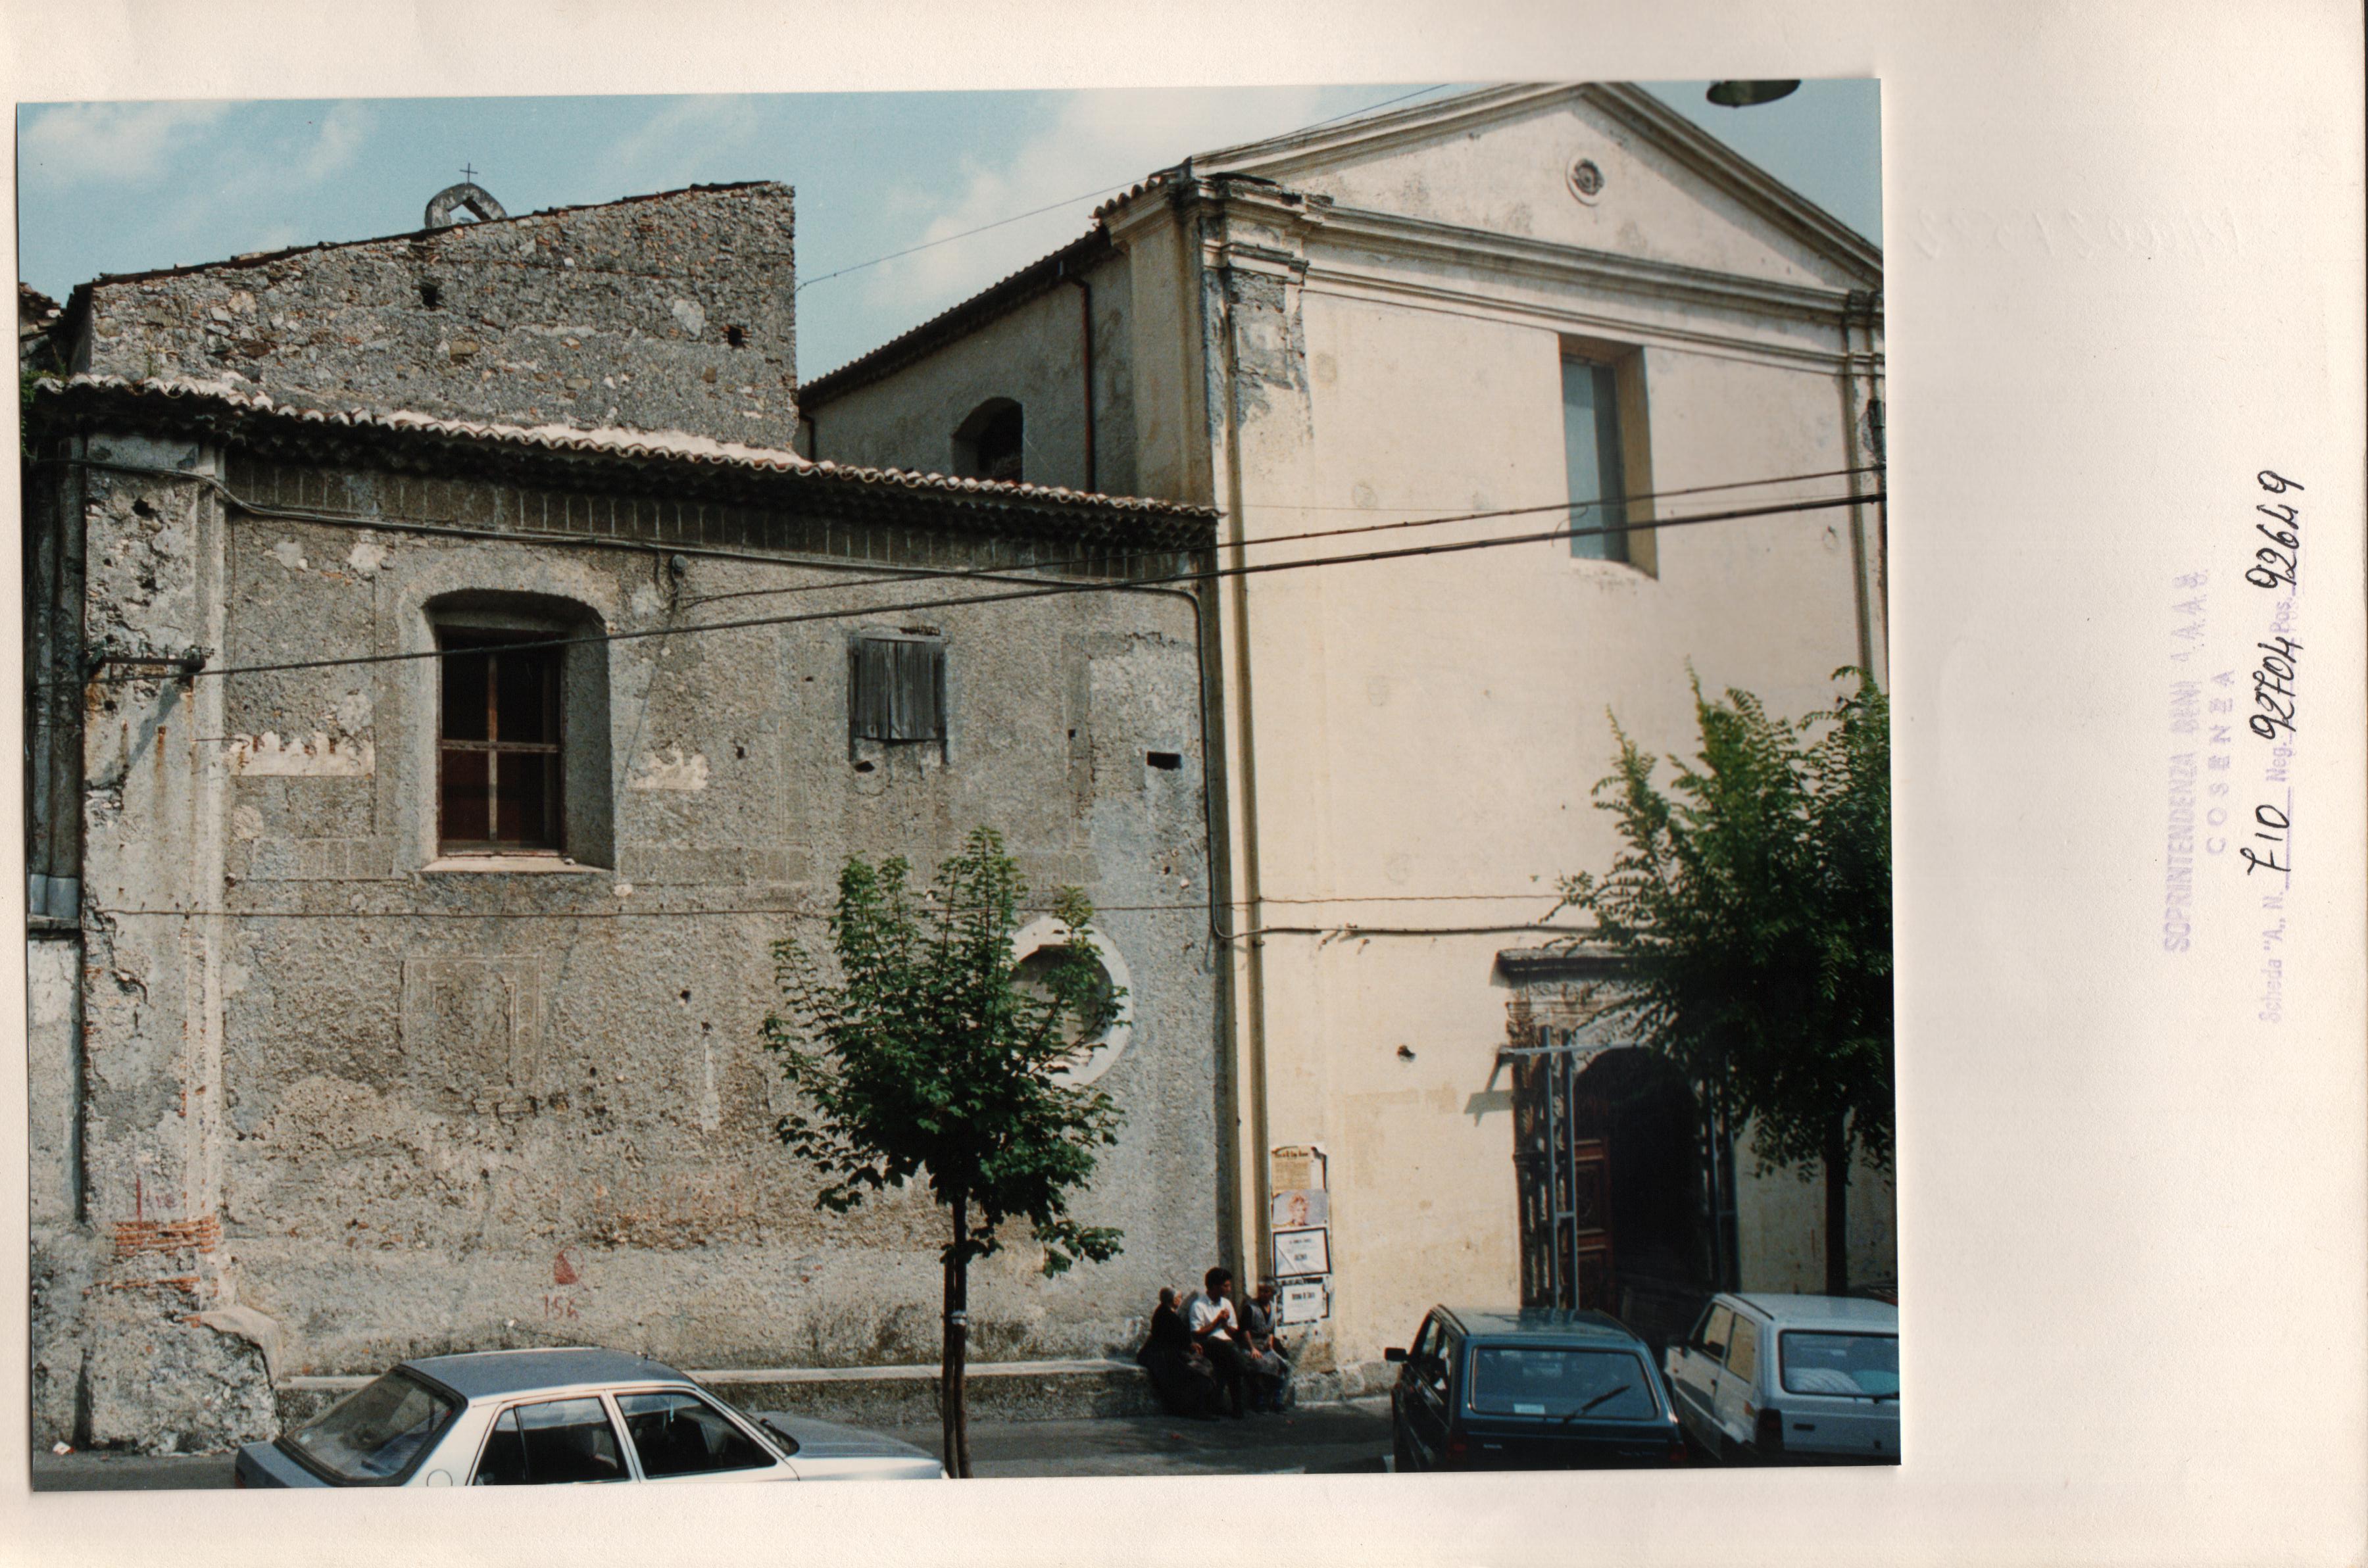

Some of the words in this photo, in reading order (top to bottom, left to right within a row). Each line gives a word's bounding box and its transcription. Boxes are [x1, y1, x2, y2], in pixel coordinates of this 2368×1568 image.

[2246, 471, 2304, 588] 92649
[2250, 637, 2303, 739] 92704
[2205, 668, 2234, 855] COSENZA
[2265, 742, 2292, 781] Neg.
[2164, 751, 2197, 954] SOPRINTENDENZA
[2262, 892, 2284, 909] N.
[2258, 959, 2282, 1023] Scheda
